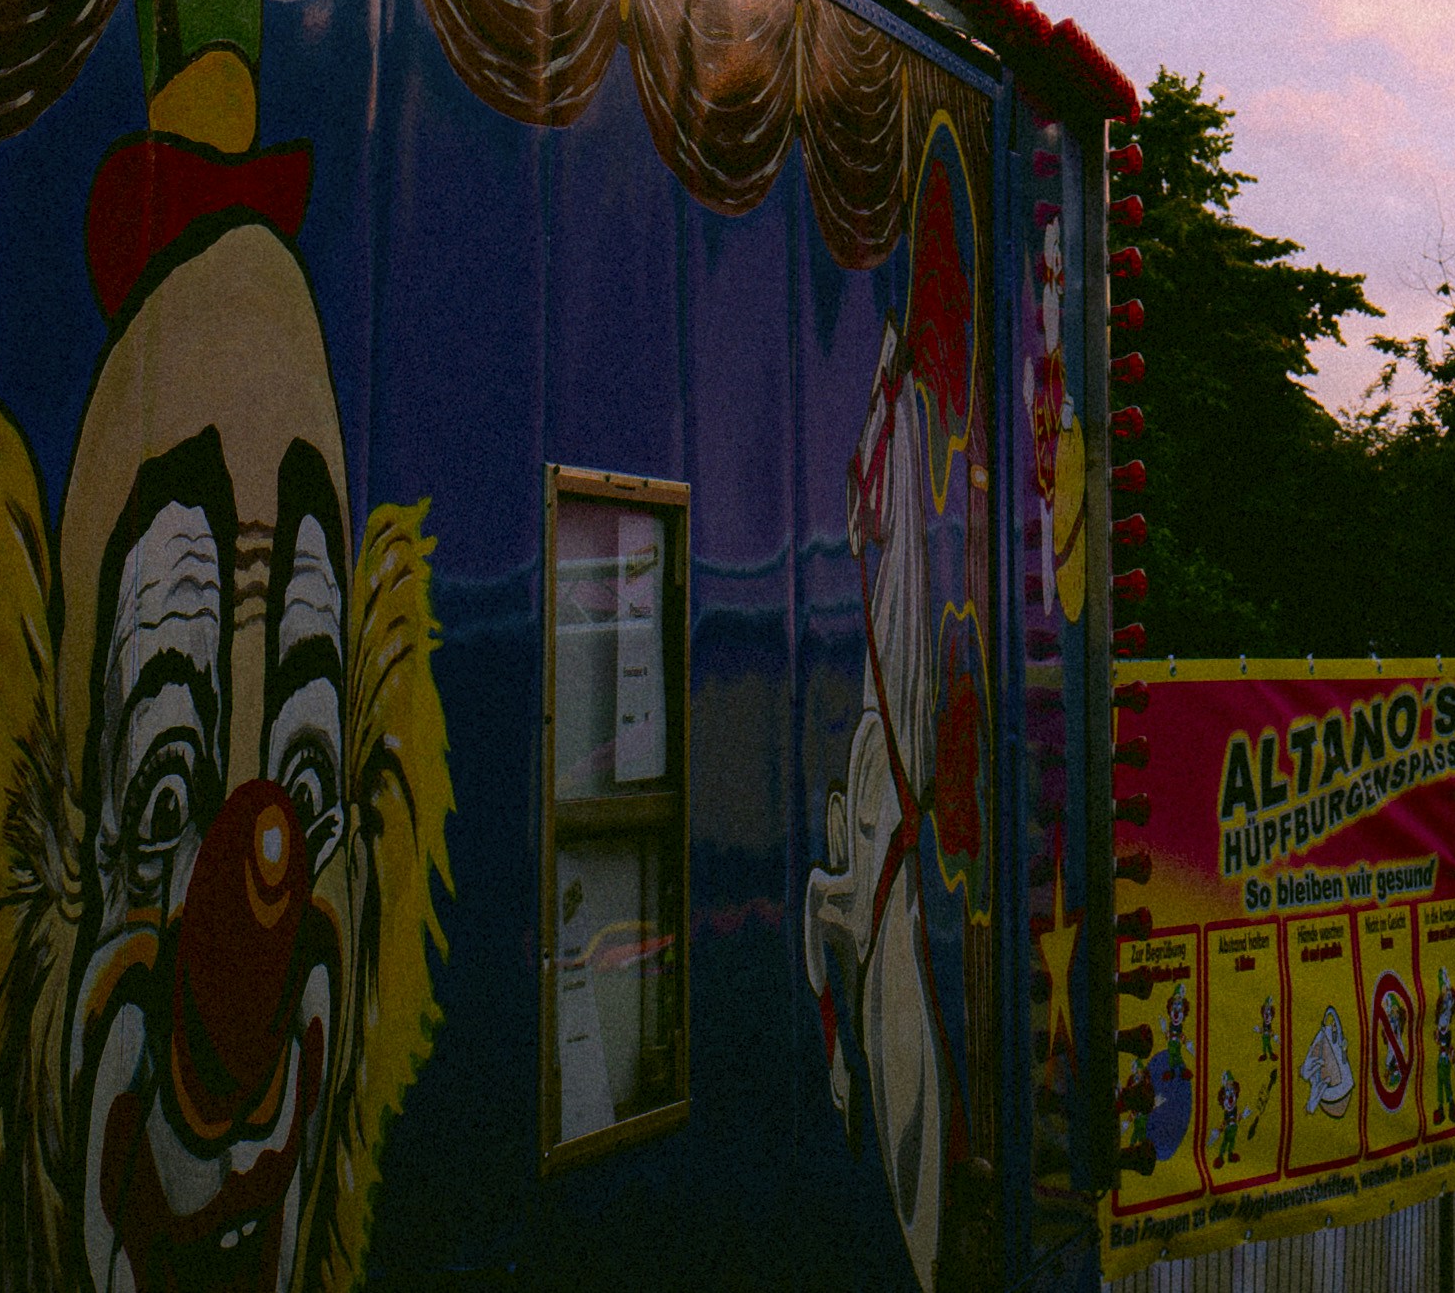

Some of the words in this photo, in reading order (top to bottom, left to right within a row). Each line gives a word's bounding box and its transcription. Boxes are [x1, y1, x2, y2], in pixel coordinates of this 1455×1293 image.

[1246, 880, 1272, 910] So
[1277, 873, 1344, 907] bleiben
[1347, 869, 1373, 898] wir
[1377, 857, 1435, 902] gesund
[1110, 1220, 1140, 1250] Bei
